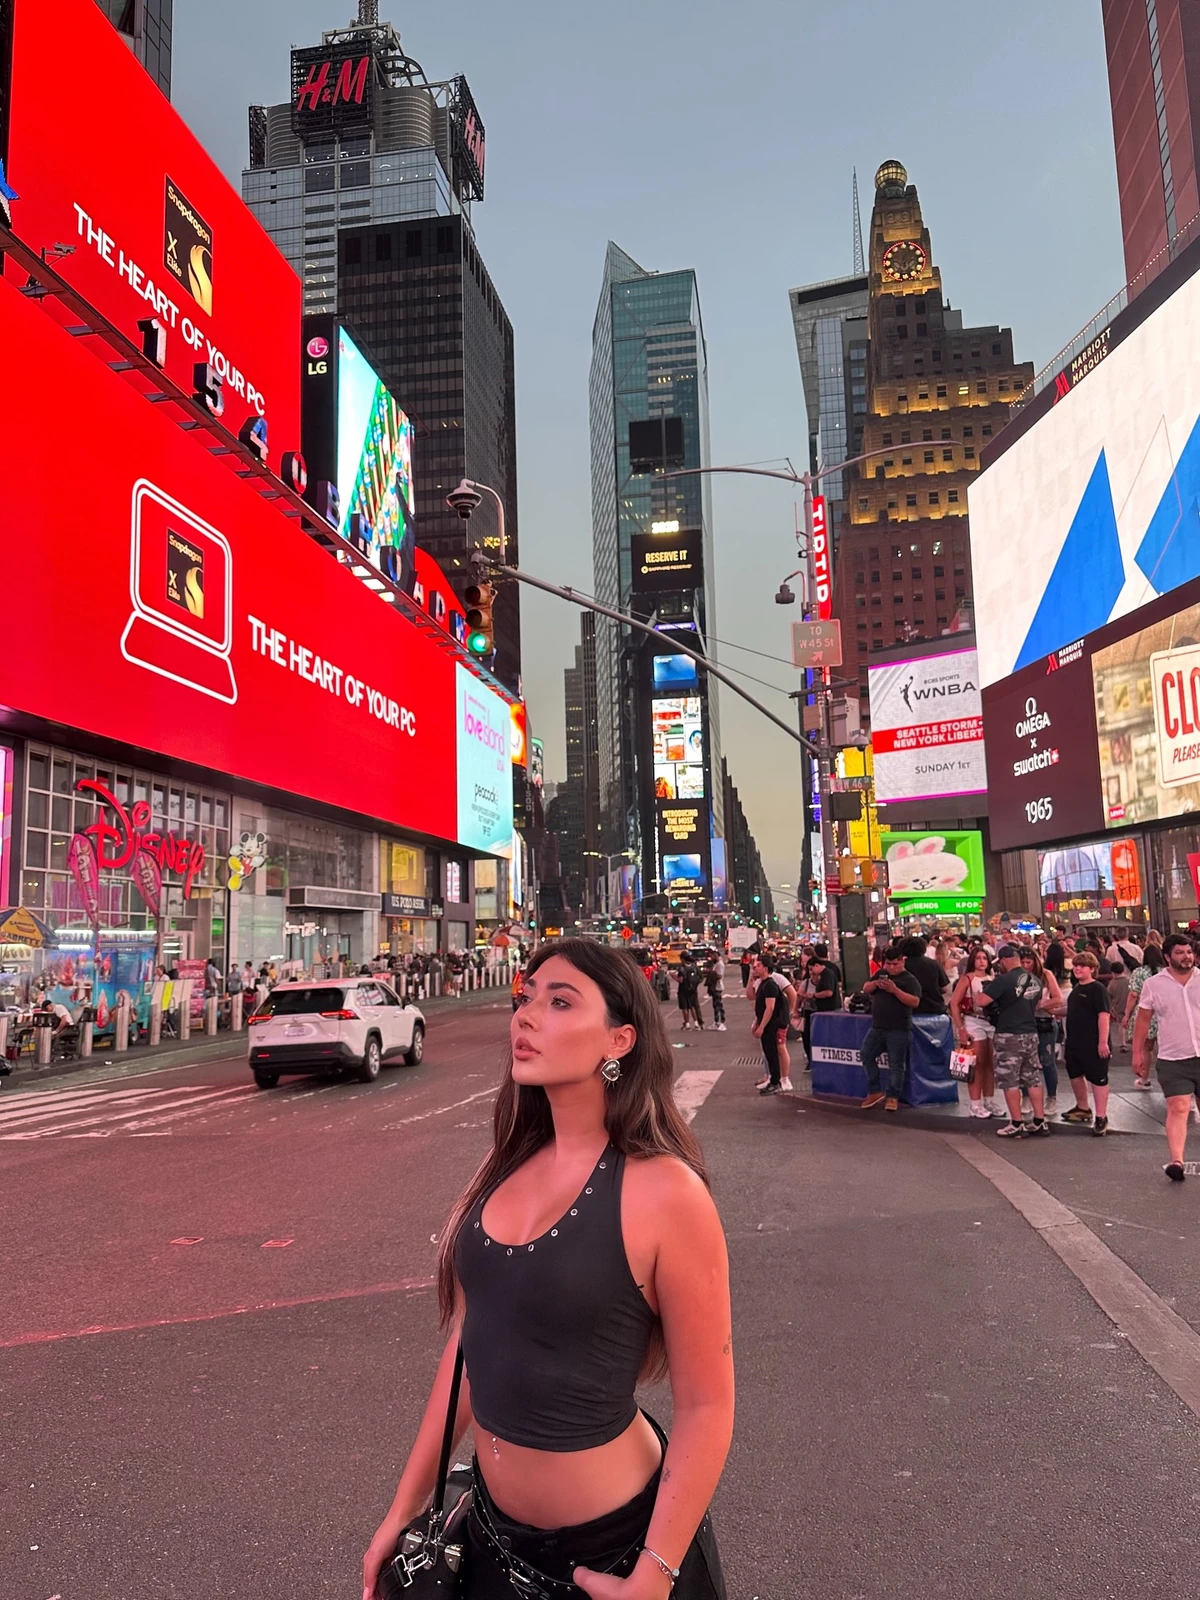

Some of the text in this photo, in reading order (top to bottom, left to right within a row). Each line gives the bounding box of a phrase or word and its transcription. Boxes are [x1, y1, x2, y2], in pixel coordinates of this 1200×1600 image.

[297, 56, 369, 111] H&M
[464, 108, 485, 177] H&M
[168, 185, 210, 244] Snapdragon
[167, 231, 177, 258] X
[74, 202, 265, 416] THE HEART OF YOUR PC
[1071, 328, 1111, 372] MARRIOTT
[307, 362, 327, 375] LG
[1072, 346, 1108, 385] MARQUIS
[168, 534, 203, 563] Snapdragon
[645, 549, 688, 563] RESERVE IT
[168, 569, 177, 588] X
[810, 626, 822, 635] TO
[800, 639, 807, 649] W
[809, 638, 822, 648] 45
[1058, 639, 1085, 658] MARRIOTT
[1059, 648, 1083, 667] MARQUIS
[248, 614, 416, 737] THE HEART OF YOUR PC
[939, 674, 960, 682] SPORTS
[913, 682, 976, 700] WNBA
[896, 719, 977, 739] SEATTLE STORM
[1015, 712, 1051, 738] OMEGA
[893, 737, 917, 749] NEW
[918, 734, 946, 746] YORK
[1013, 748, 1052, 776] swatch
[1172, 742, 1200, 764] PLEASE
[915, 762, 956, 774] SUNDAY
[852, 778, 863, 788] 46
[474, 783, 497, 804] peacock
[1025, 797, 1053, 824] 1965
[955, 901, 979, 909] KPOP
[820, 1049, 853, 1062] TIMES
